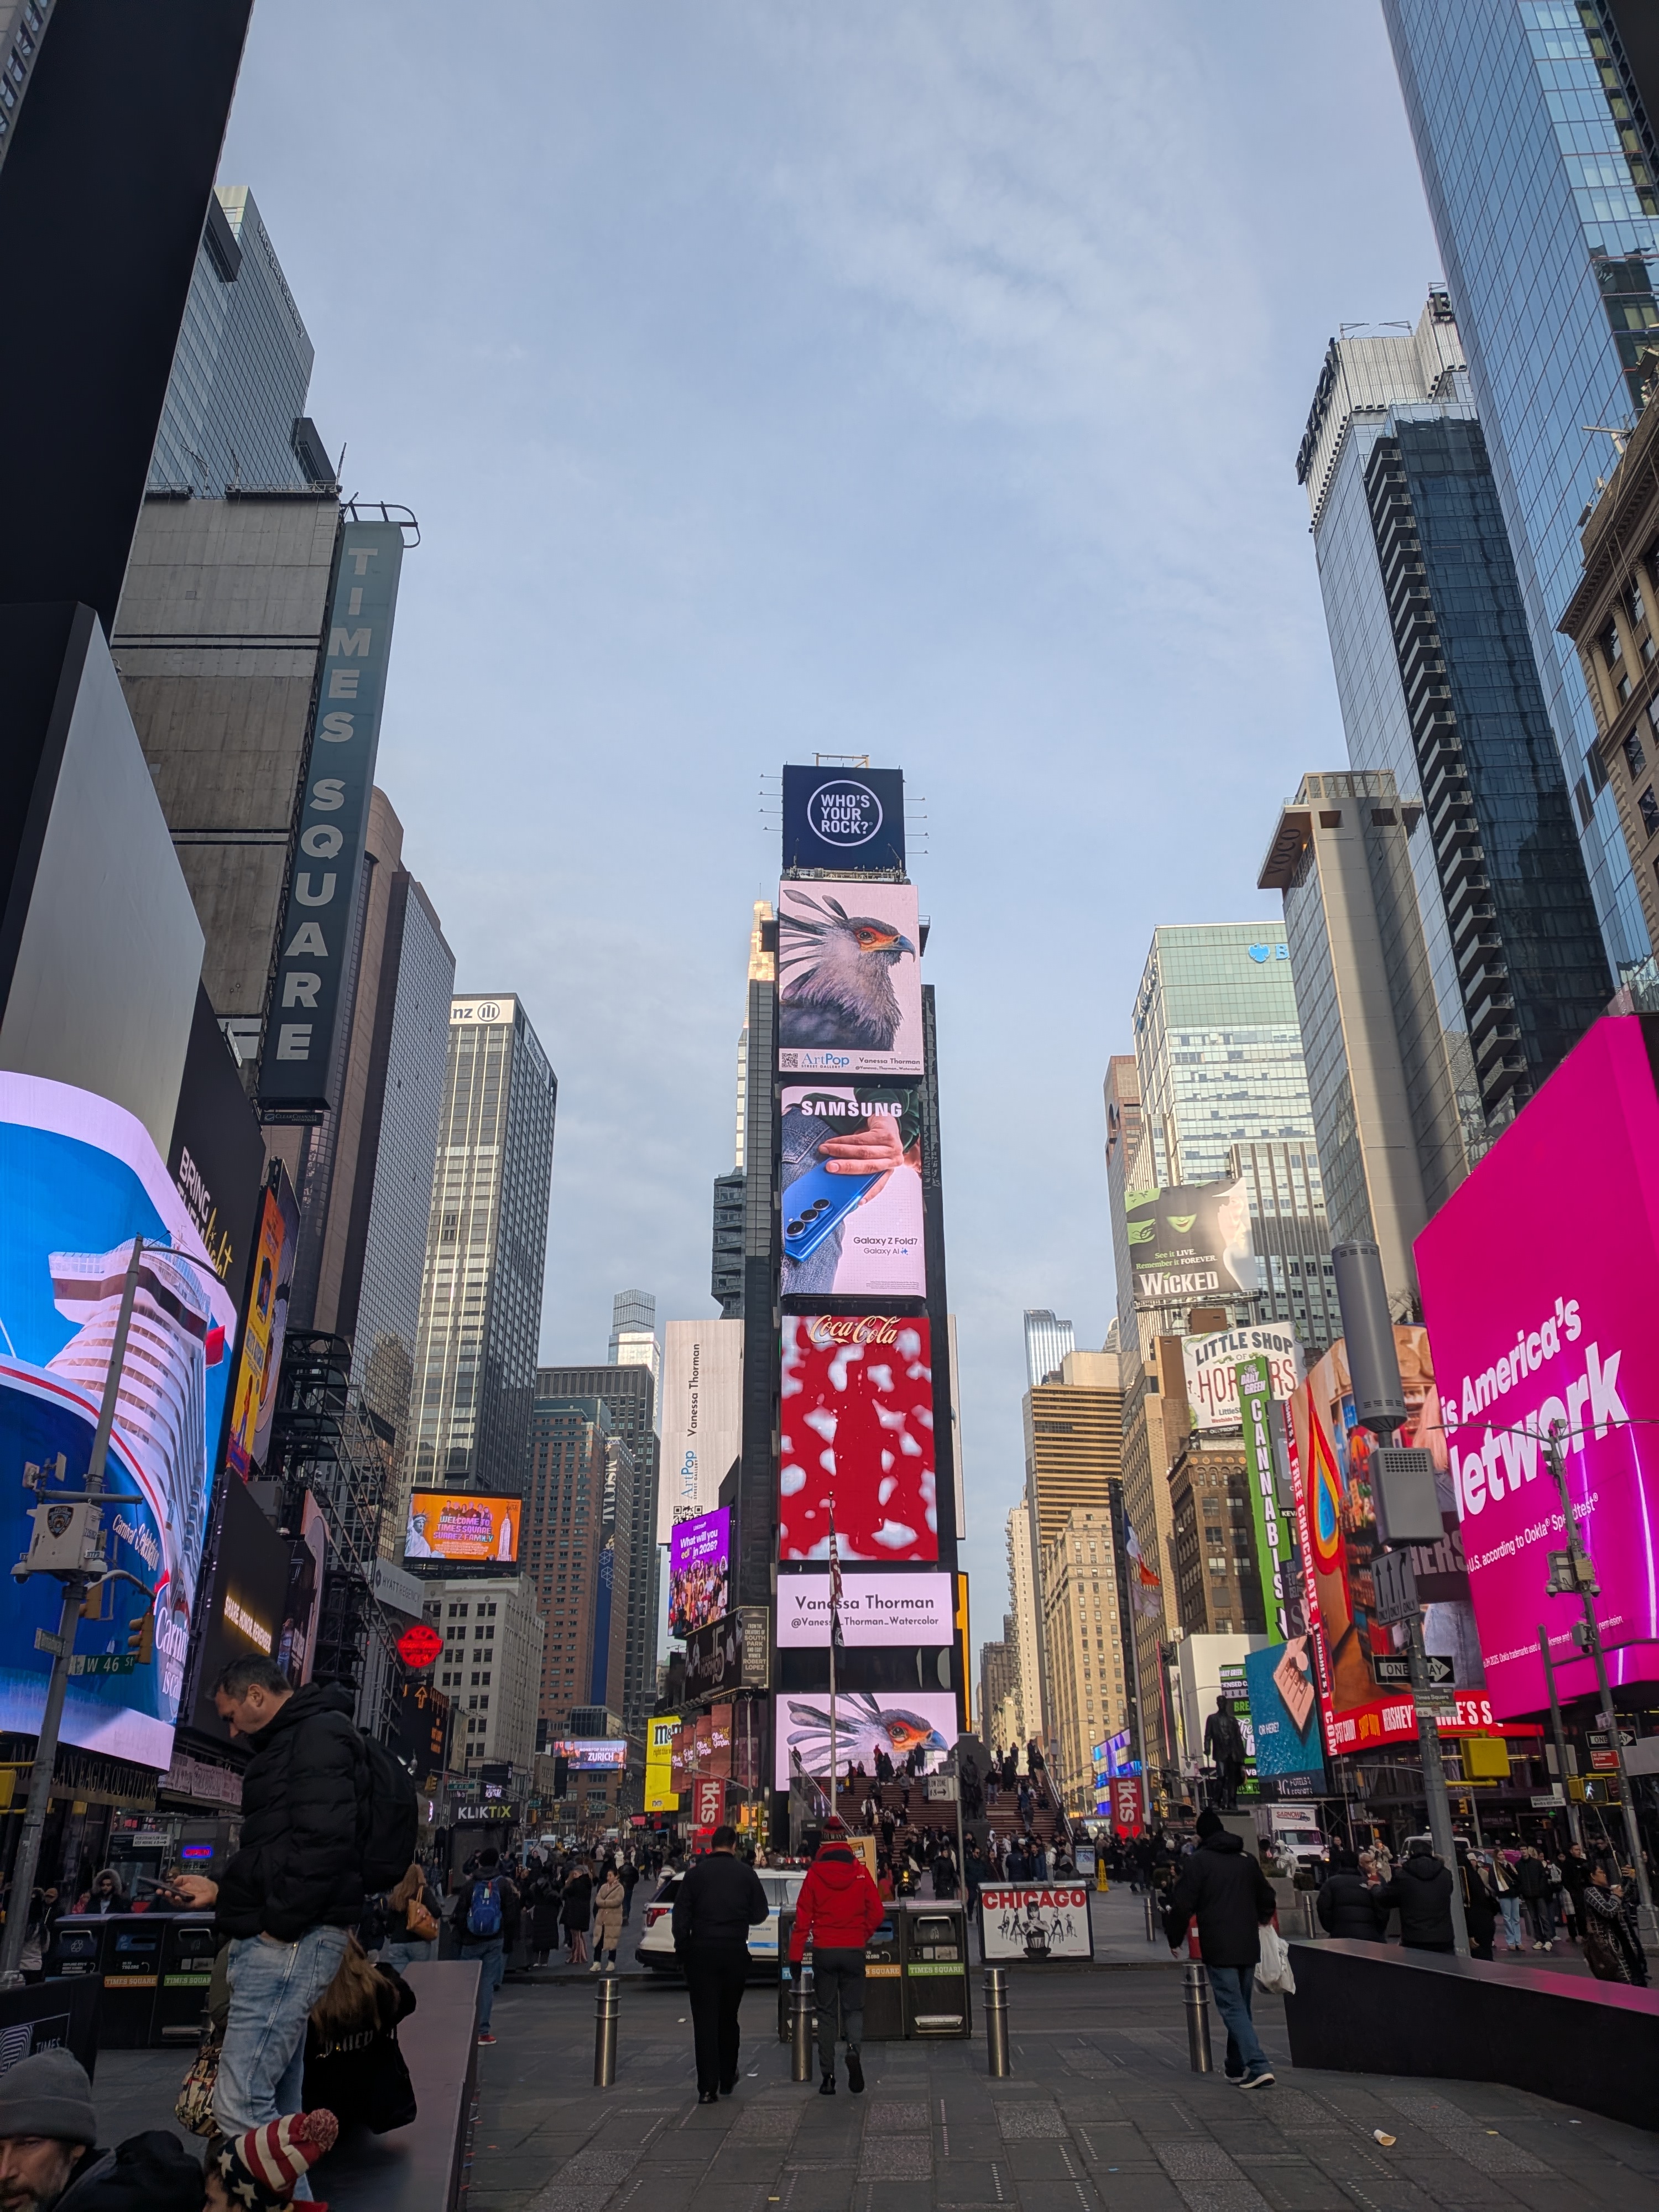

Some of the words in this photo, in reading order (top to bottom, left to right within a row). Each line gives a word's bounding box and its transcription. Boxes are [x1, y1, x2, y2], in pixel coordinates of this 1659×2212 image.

[258, 221, 283, 285] Morgan
[282, 281, 305, 338] Stanley
[320, 547, 378, 743] TIMES
[821, 794, 870, 808] WHO'S
[821, 807, 862, 821] YOUR
[276, 778, 345, 1061] SQUARE
[801, 1053, 850, 1067] ArtPop
[801, 1100, 902, 1117] SAMSUNG
[179, 1146, 211, 1224] BRING
[853, 1237, 886, 1247] Galaxy
[894, 1237, 918, 1245] Fold7
[863, 1248, 891, 1256] Galaxy
[1155, 1251, 1168, 1259] See
[1169, 1250, 1175, 1258] it
[1135, 1259, 1172, 1270] Remember
[809, 1314, 902, 1345] Coca-Cola
[1195, 1332, 1248, 1366] LITTLE
[1252, 1332, 1293, 1357] SHOP
[688, 1344, 700, 1390] Thorman
[1440, 1396, 1458, 1438] is
[1462, 1296, 1582, 1424] America's
[1198, 1359, 1296, 1417] HORRS
[687, 1392, 698, 1437] Vanessa
[680, 1450, 697, 1499] ArtPop
[1291, 1457, 1304, 1501] FREE
[1250, 1398, 1285, 1599] CANNABIS
[440, 1515, 479, 1525] WELCOME
[112, 1514, 137, 1545] Carnival
[433, 1532, 462, 1541] SUAREZ
[464, 1533, 494, 1542] FAMILY
[436, 1524, 461, 1532] TIMES
[461, 1526, 493, 1535] SQUARE
[680, 1535, 696, 1548] What
[696, 1531, 707, 1543] will
[707, 1529, 718, 1542] you
[699, 1540, 718, 1554] 2026?
[1468, 1554, 1482, 1573] U.S.
[1482, 1539, 1516, 1566] according
[1516, 1535, 1525, 1550] to
[1297, 1504, 1318, 1613] CHOCOLATE
[382, 1576, 399, 1593] HYATT
[399, 1584, 420, 1602] REGENCY
[223, 1595, 240, 1626] SHARE
[865, 1594, 934, 1609] Thorman
[791, 1616, 939, 1629] @Vaness_Thorman_Watercolor
[87, 1657, 99, 1672] W
[103, 1657, 119, 1672] 46
[125, 1656, 134, 1667] St
[1386, 1664, 1410, 1675] ONE
[1429, 1664, 1443, 1675] AY
[712, 1732, 723, 1740] Olive
[1258, 1725, 1266, 1736] OR
[1266, 1721, 1280, 1734] HERE?
[697, 1741, 708, 1749] Olive
[713, 1739, 730, 1749] Garden
[588, 1752, 614, 1762] ZURICH
[111, 1765, 158, 1802] OUTFITTERS
[701, 1781, 720, 1823] tkts
[1118, 1780, 1137, 1823] tkts
[458, 1805, 512, 1819] KLIKTIX
[982, 1889, 1086, 1910] CHICAGO
[910, 1966, 934, 1974] TIMES
[936, 1965, 963, 1974] SQUARE
